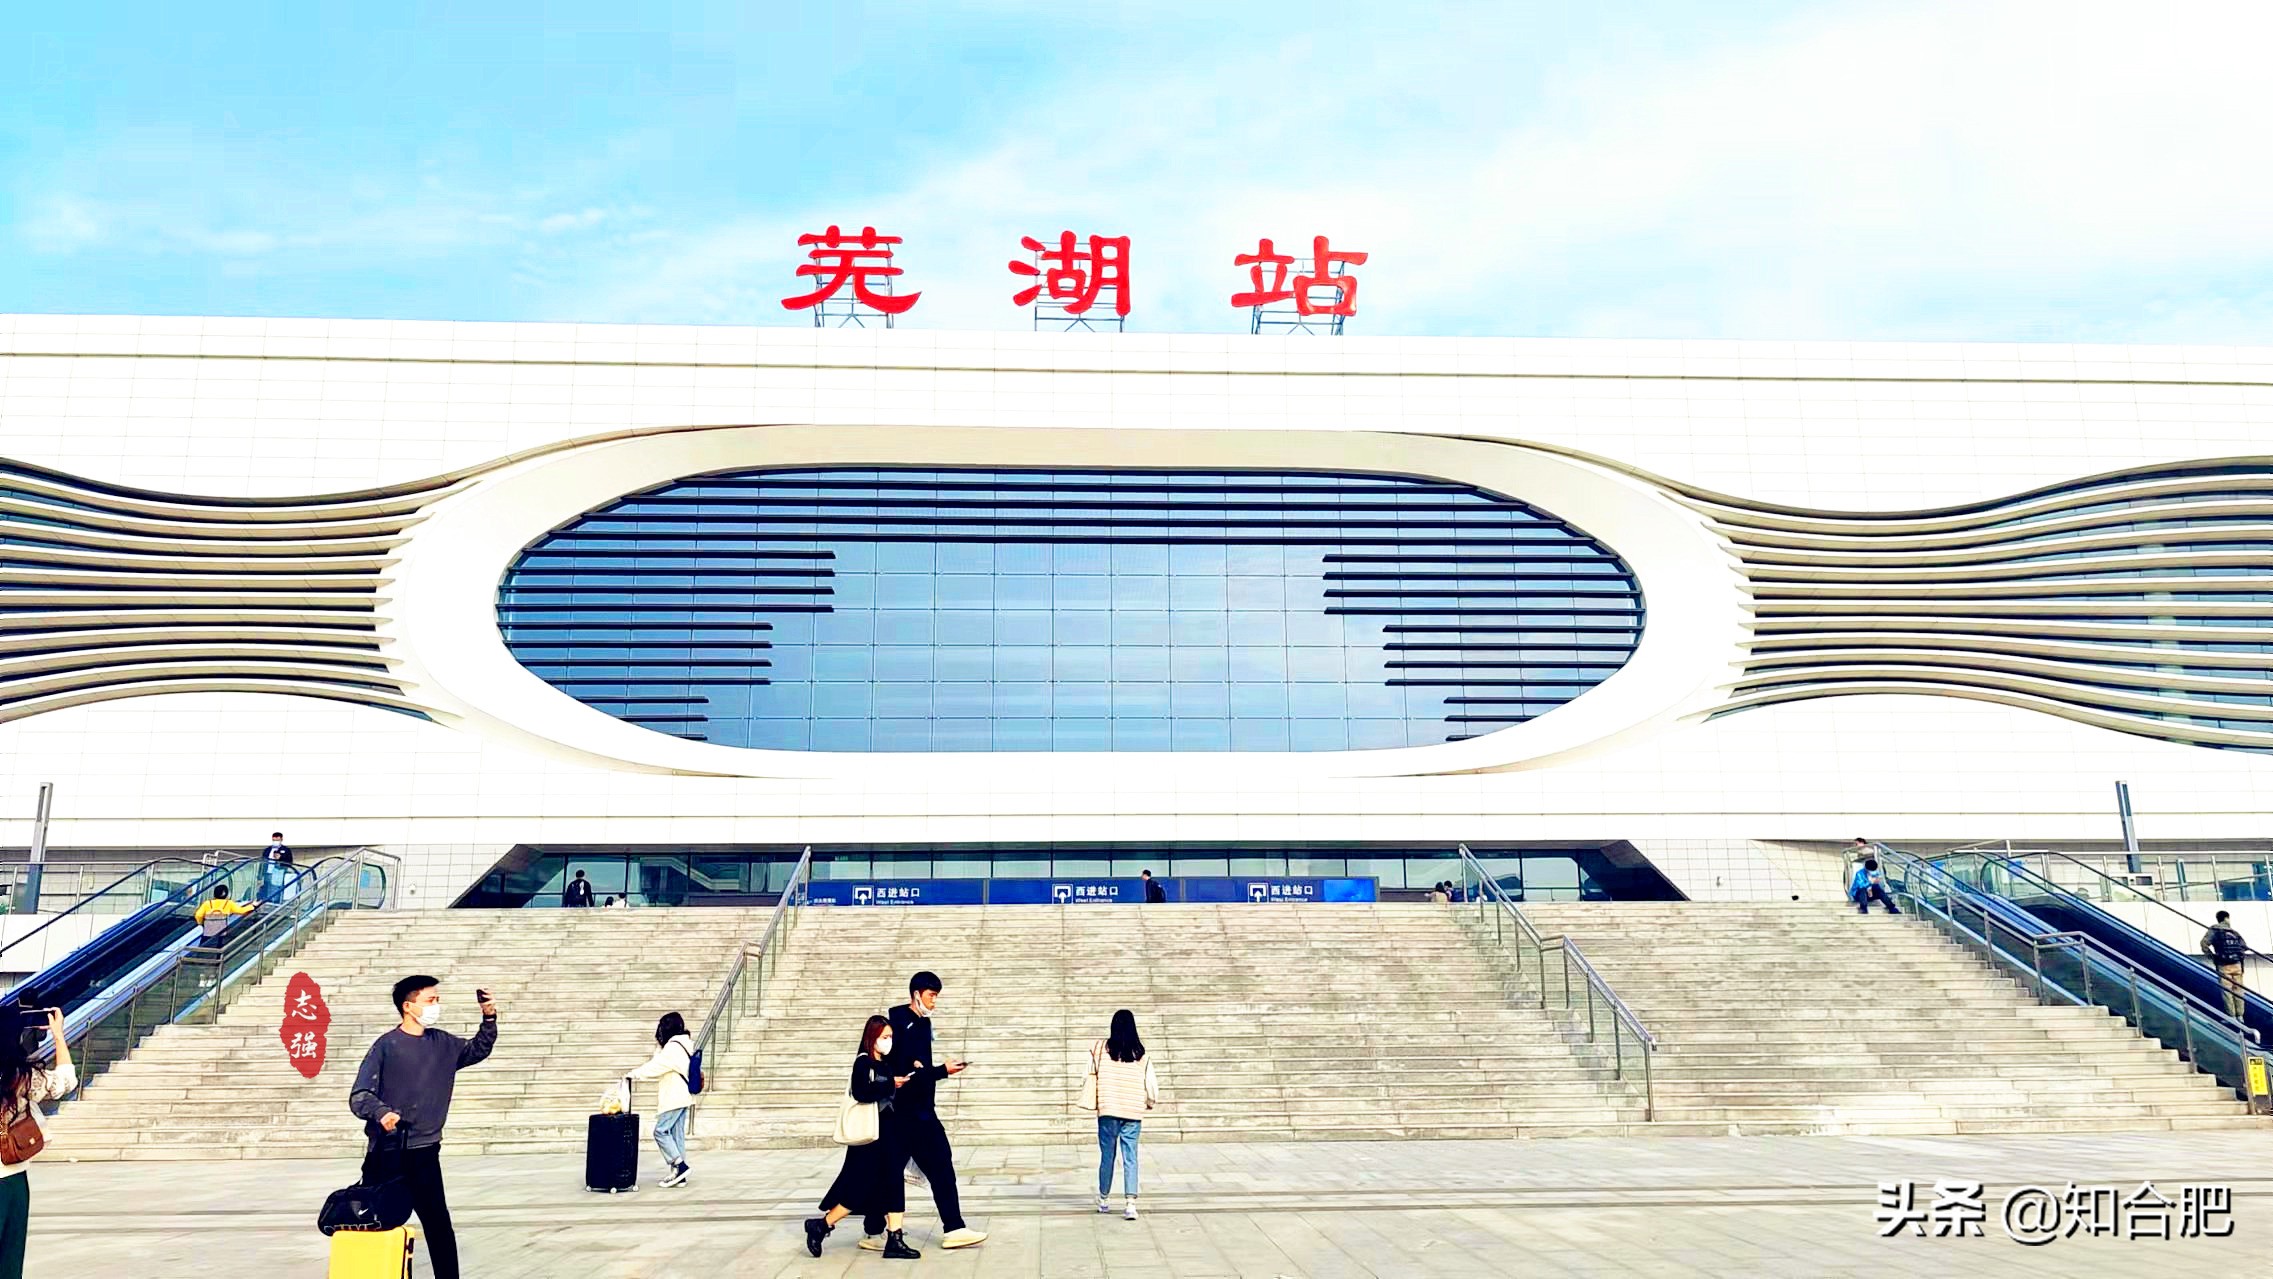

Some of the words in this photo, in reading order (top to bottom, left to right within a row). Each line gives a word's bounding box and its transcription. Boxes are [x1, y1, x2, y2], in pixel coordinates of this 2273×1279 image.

[781, 225, 1369, 317] 芜湖站
[876, 887, 920, 898] 西进站口
[1075, 886, 1119, 897] 西进站口
[1271, 885, 1313, 896] 西进站口
